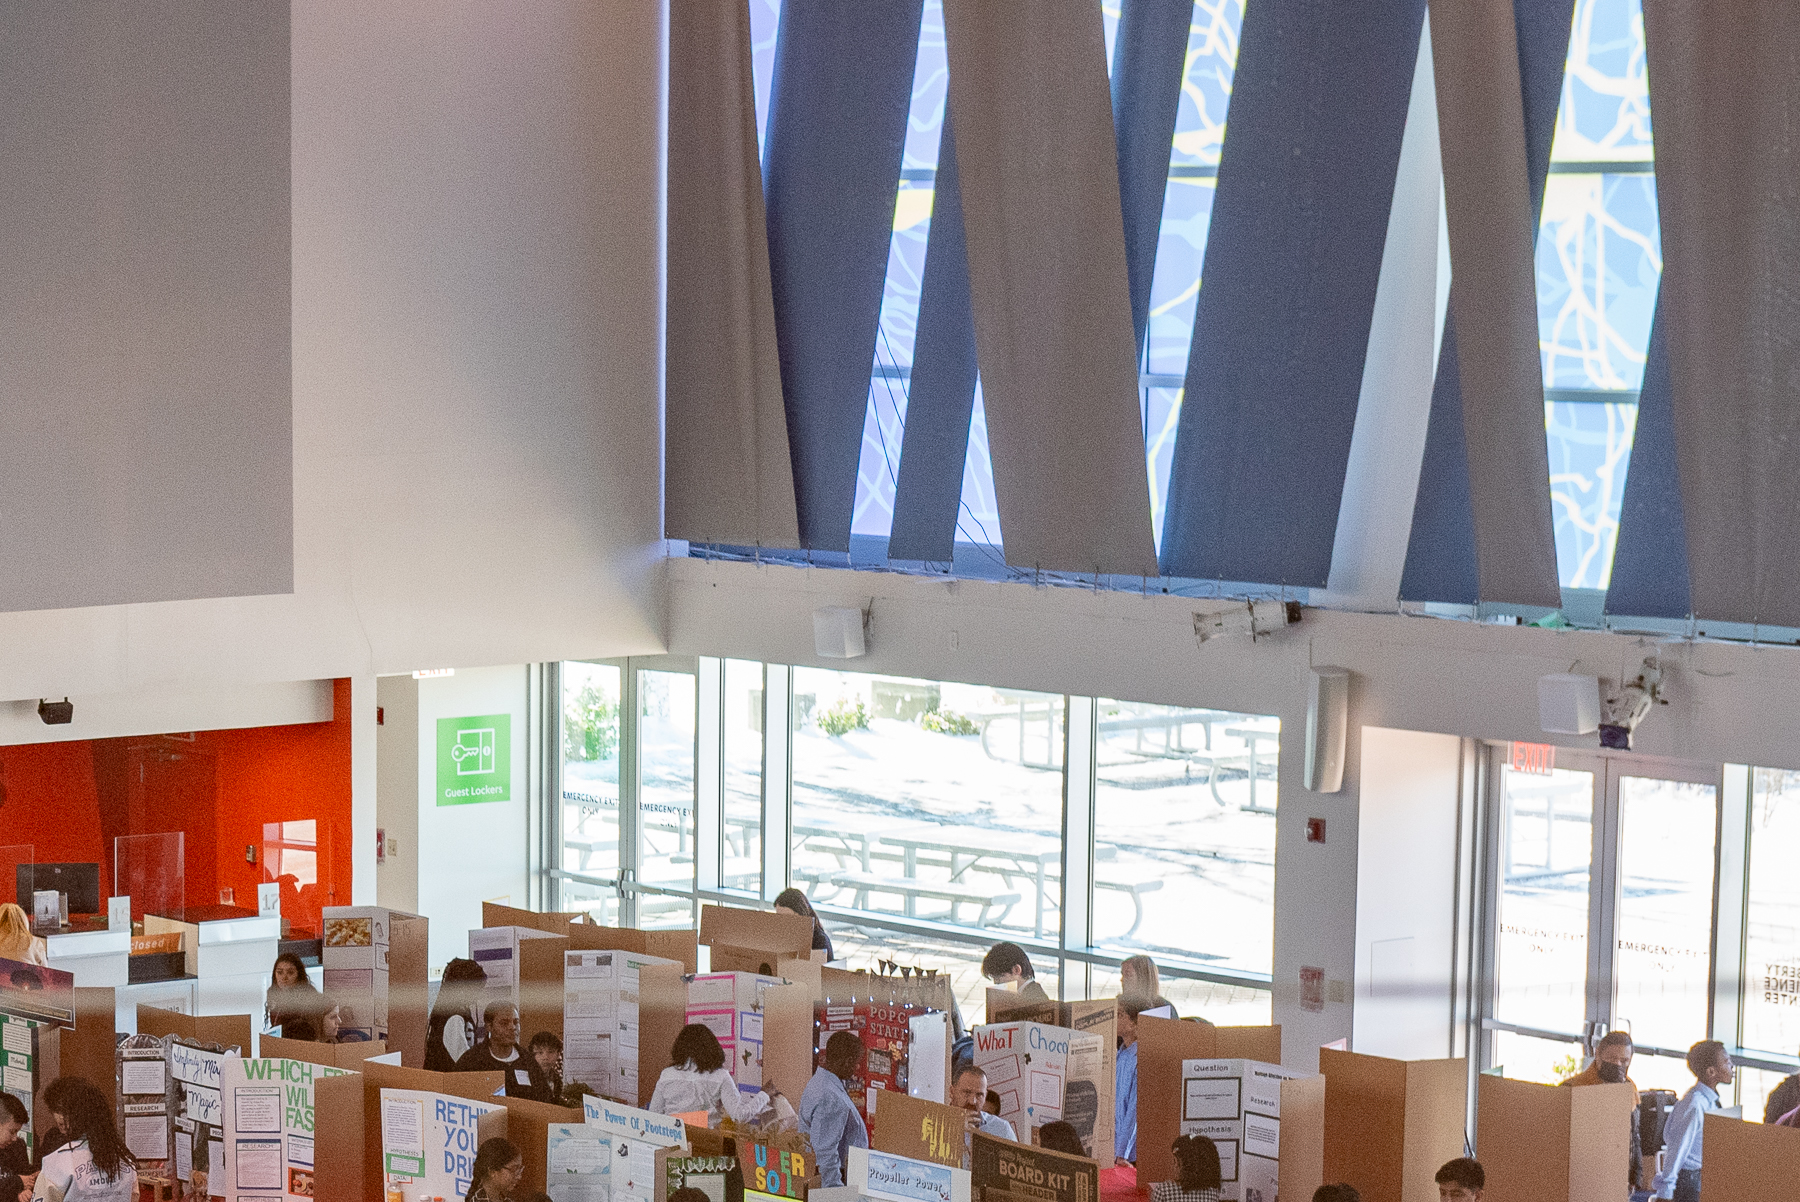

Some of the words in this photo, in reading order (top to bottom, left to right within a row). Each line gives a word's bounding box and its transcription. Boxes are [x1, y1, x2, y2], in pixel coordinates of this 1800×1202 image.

[1513, 741, 1551, 773] EXIT
[445, 785, 469, 798] Guest
[471, 784, 503, 797] Lockers
[563, 791, 602, 805] EMERGENCY
[639, 802, 681, 816] EMERGENCY
[262, 892, 277, 911] 17
[131, 938, 165, 950] closed
[243, 1059, 312, 1084] WHICH
[1193, 1064, 1228, 1073] Question
[1250, 1098, 1276, 1107] Research
[585, 1104, 599, 1119] The
[604, 1108, 626, 1126] Power
[631, 1116, 640, 1129] Of
[644, 1120, 682, 1141] Footsteps
[1189, 1125, 1231, 1135] Hypothesis
[745, 1142, 805, 1178] SUPER
[755, 1166, 797, 1198] SOIL
[869, 1166, 910, 1187] Propeller
[1000, 1161, 1043, 1185] BOARD
[1048, 1171, 1070, 1190] KIT
